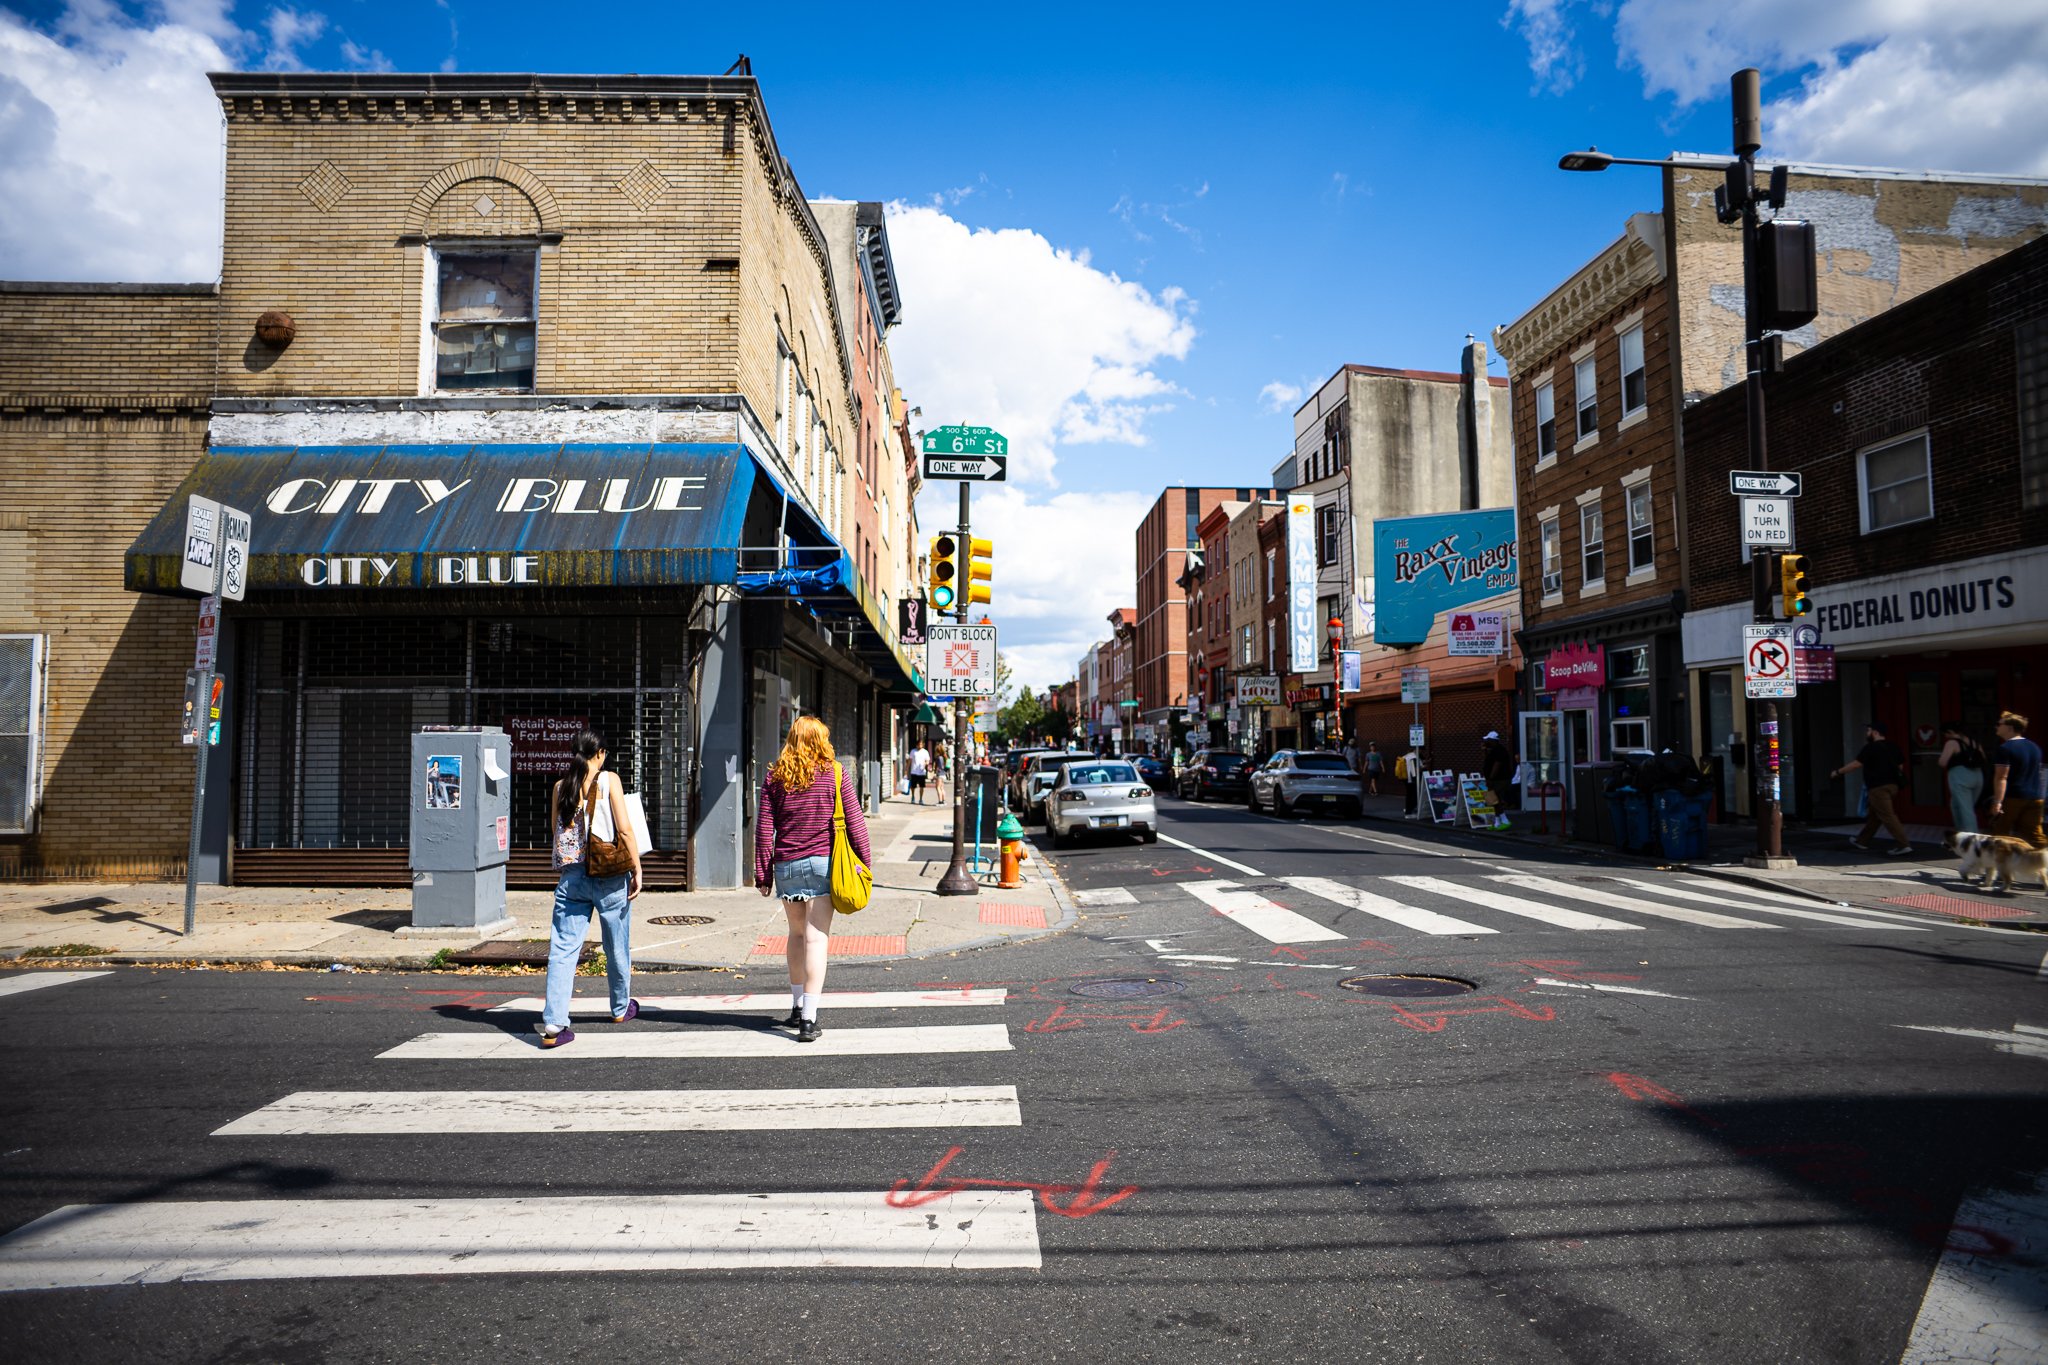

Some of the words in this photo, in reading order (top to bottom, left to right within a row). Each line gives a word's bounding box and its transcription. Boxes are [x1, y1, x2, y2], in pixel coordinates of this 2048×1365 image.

[962, 427, 970, 435] S
[952, 436, 976, 453] 6th
[984, 439, 1004, 454] St
[934, 462, 956, 472] ONE
[962, 462, 982, 472] WAY
[1738, 478, 1756, 488] ONE
[1759, 480, 1778, 488] WAY
[266, 477, 471, 515] CITY
[496, 476, 707, 514] BLUE
[1758, 504, 1774, 512] NO
[1754, 517, 1780, 526] TURN
[1748, 530, 1762, 538] ON
[1766, 530, 1786, 540] RED
[1394, 538, 1410, 549] THE
[1394, 534, 1461, 584] Raxx
[1438, 540, 1518, 586] Vintage
[302, 558, 398, 586] CITY
[438, 556, 539, 584] BLUE
[1816, 594, 1905, 634] FEDERAL
[1909, 575, 2015, 621] DONUTS
[1478, 616, 1499, 625] MSC
[930, 628, 958, 640] DON'T
[962, 628, 993, 640] BLOCK
[1751, 628, 1786, 636] TRUCKS
[200, 638, 210, 647] FIRE
[1550, 666, 1572, 678] Scoop
[1572, 661, 1598, 674] DeVille
[931, 679, 956, 692] THE
[512, 718, 544, 728] Retail
[548, 718, 582, 730] Space
[520, 730, 540, 741] For
